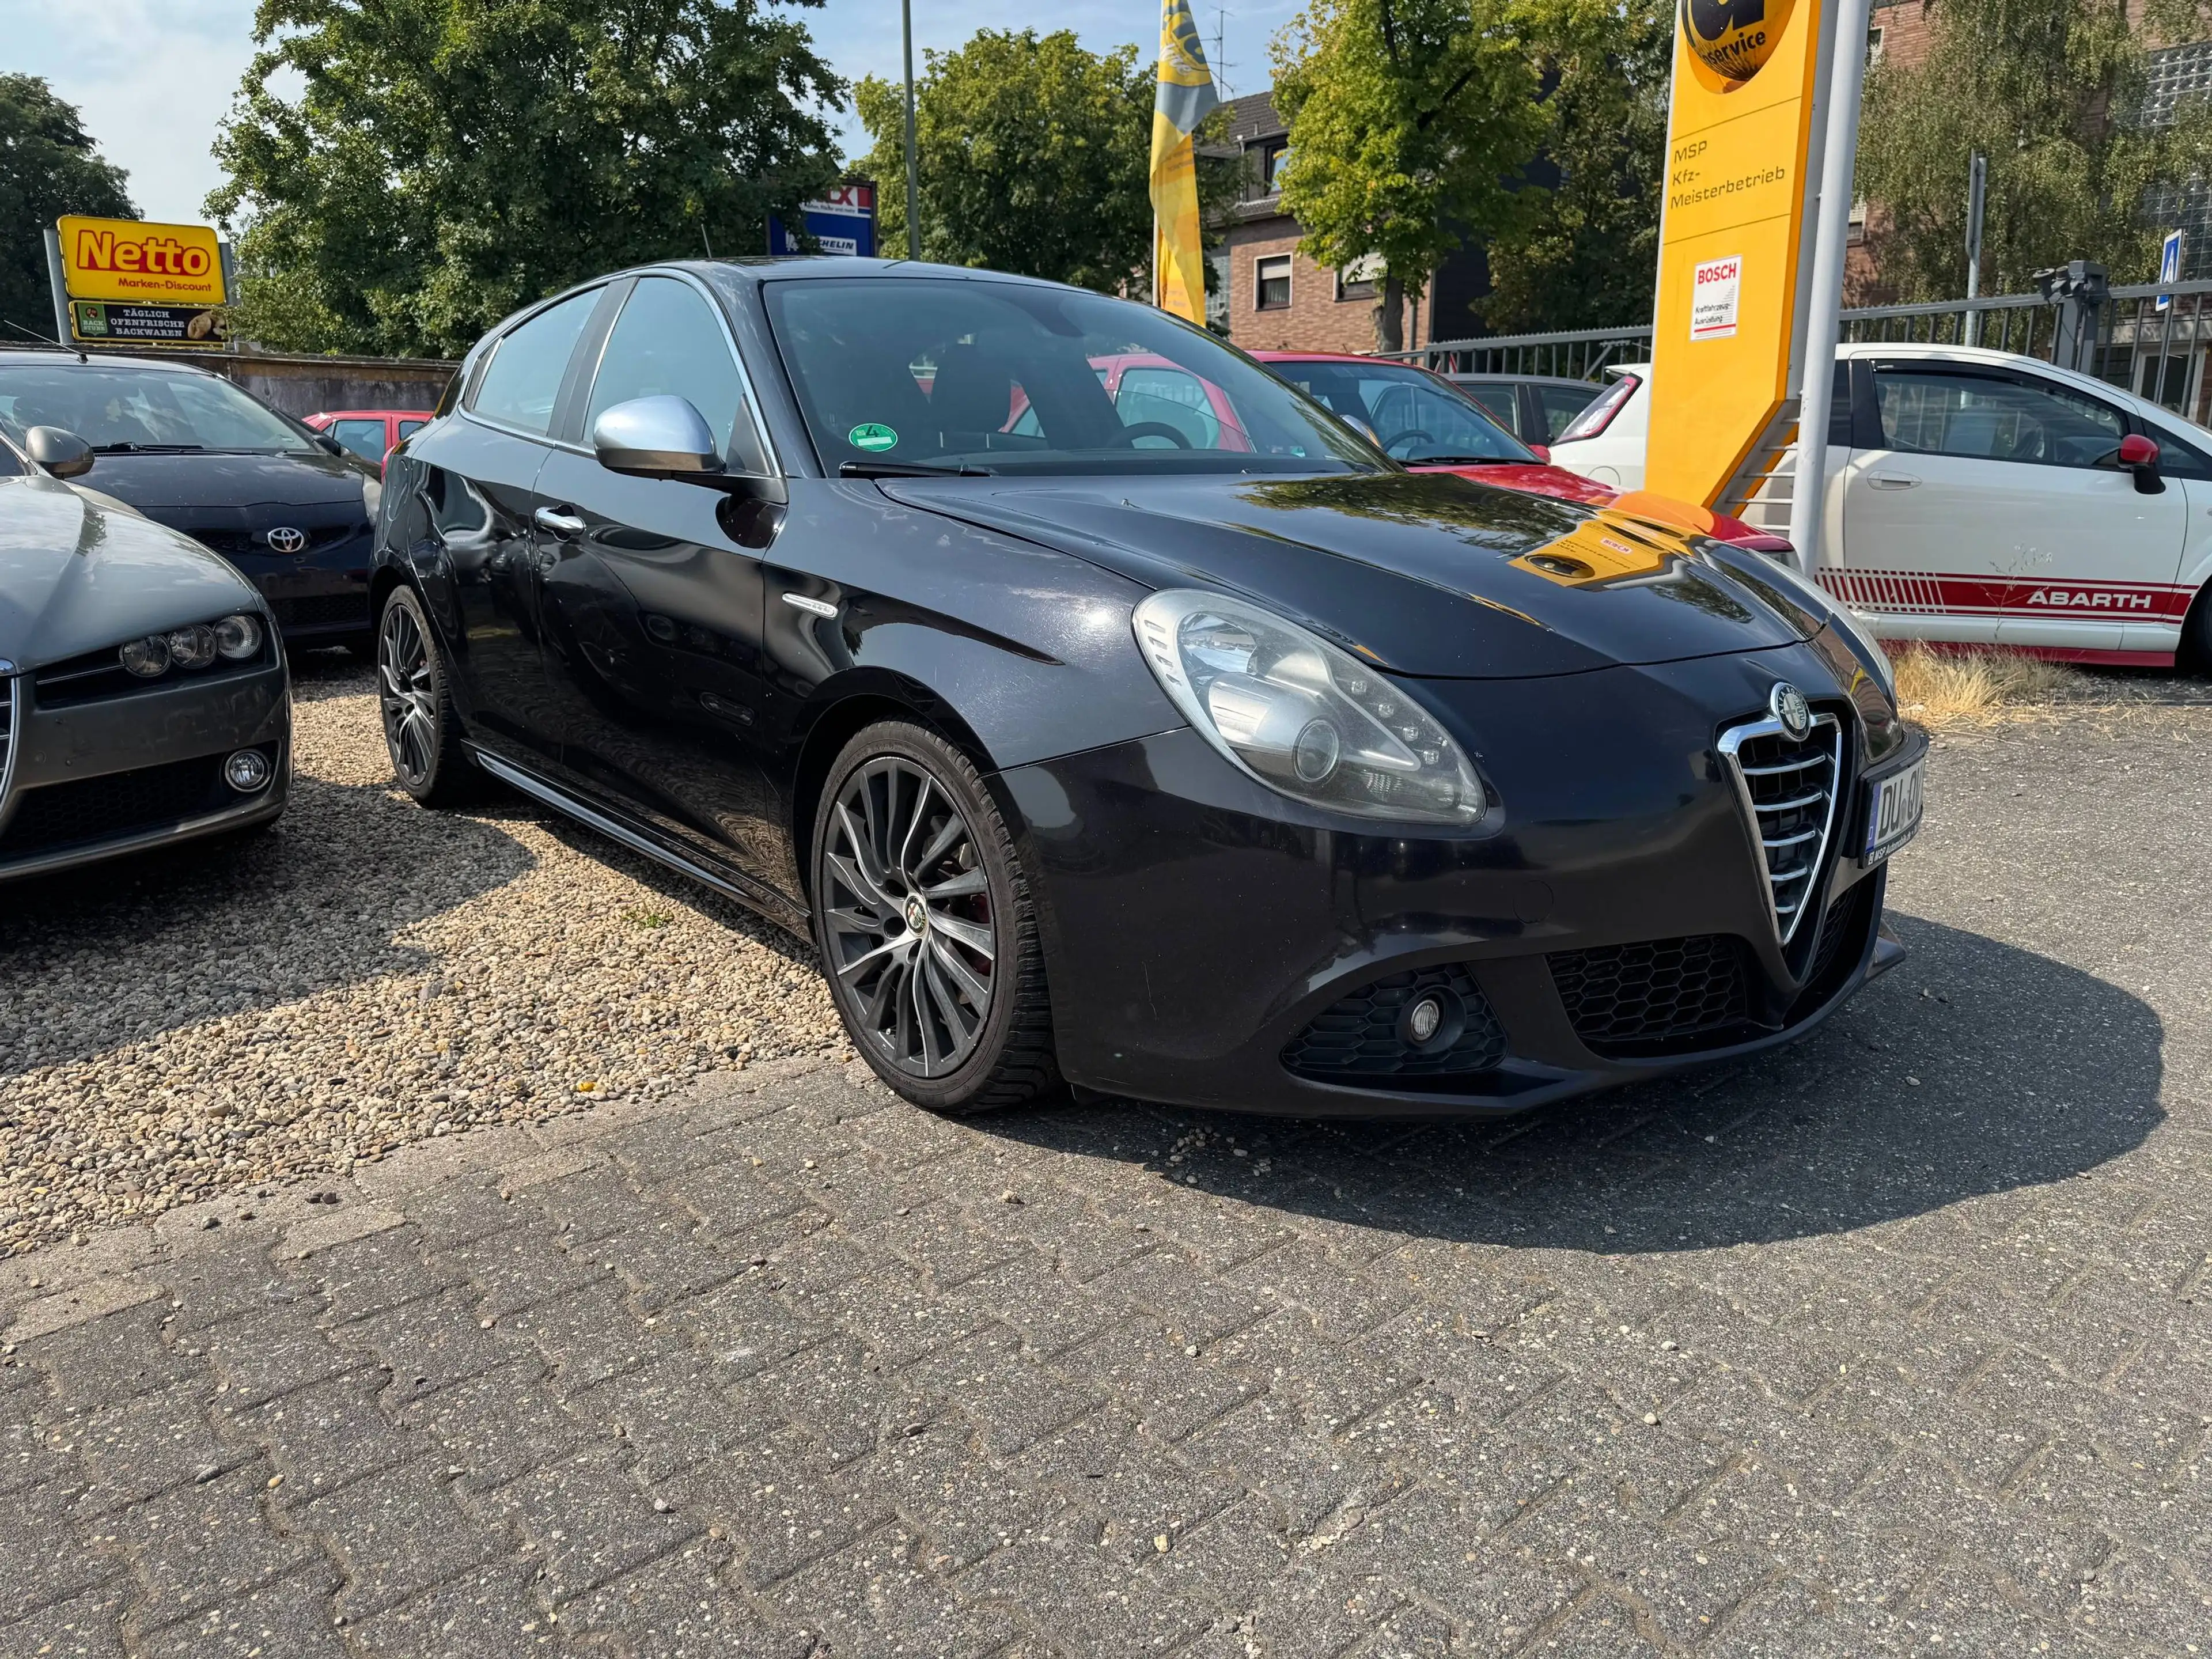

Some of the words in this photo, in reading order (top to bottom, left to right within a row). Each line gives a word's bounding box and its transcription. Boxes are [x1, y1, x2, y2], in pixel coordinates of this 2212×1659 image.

[1674, 141, 1707, 164] MSP
[1672, 169, 1700, 187] Kfz-
[1671, 166, 1785, 209] Meisterbetrieb
[77, 229, 211, 276] Netto
[819, 240, 854, 250] HELIN
[1698, 262, 1737, 285] BOSCH
[118, 277, 211, 292] Marken-Discount
[123, 308, 171, 319] TÄGLICH
[111, 318, 185, 328] OFENFRISCHE
[115, 327, 183, 337] BACKWAREN
[866, 425, 880, 437] 4
[2026, 590, 2152, 609] ABARTH
